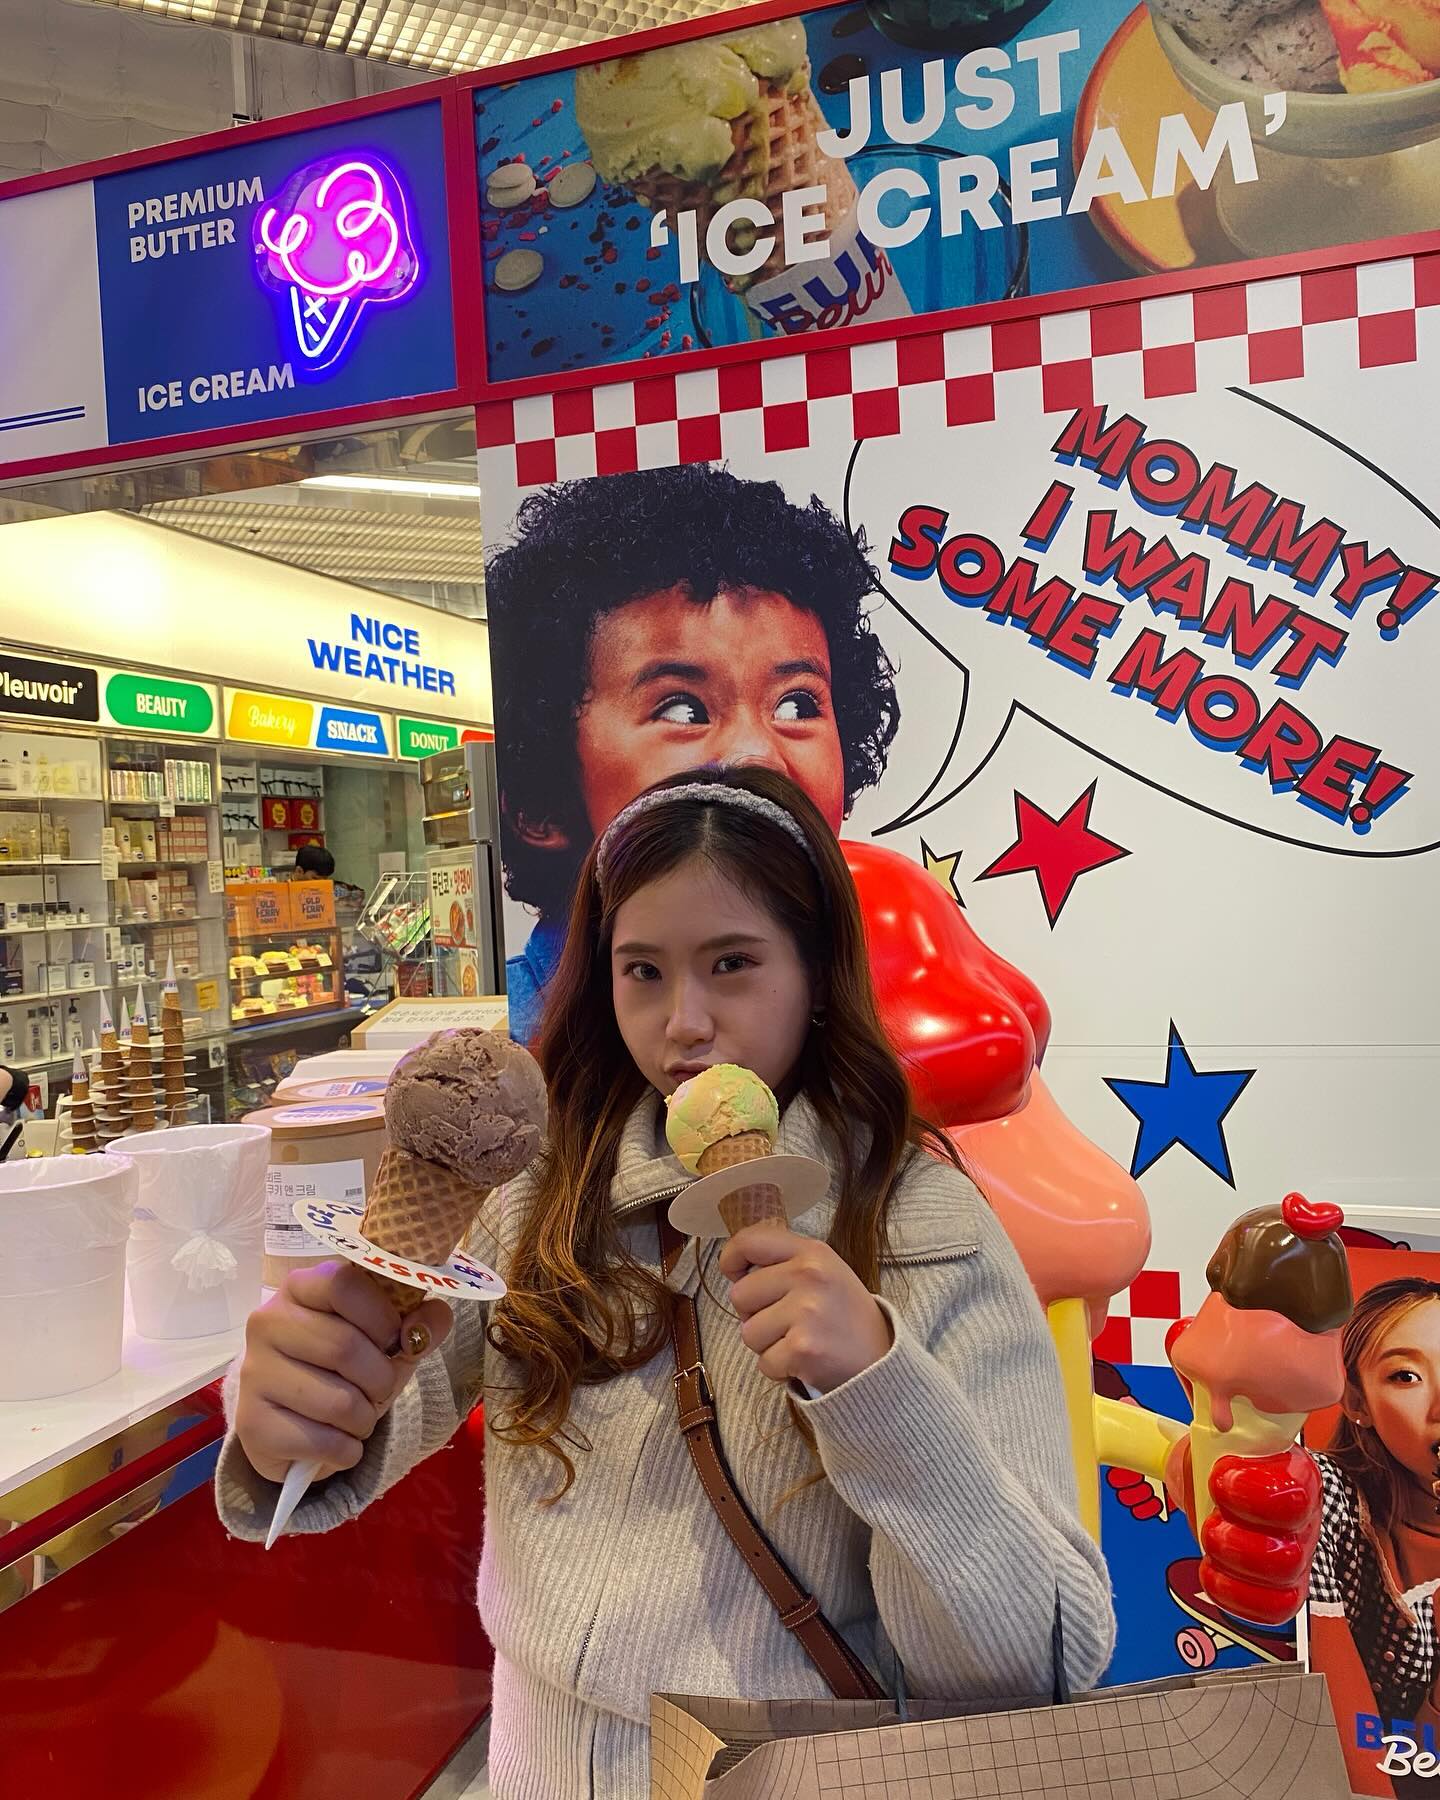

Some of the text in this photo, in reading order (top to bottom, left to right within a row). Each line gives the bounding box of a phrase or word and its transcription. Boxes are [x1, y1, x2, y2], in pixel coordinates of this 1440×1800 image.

[817, 29, 1081, 161] JUST
[128, 176, 265, 229] PREMIUM
[130, 218, 236, 263] BUTTER
[139, 362, 295, 413] ICE CREAM
[1050, 404, 1440, 641] MOMMY!
[1019, 480, 1350, 690] I WANT
[351, 613, 420, 656] NICE
[307, 639, 456, 696] WEATHER
[888, 505, 1414, 835] SOME MORE!
[136, 693, 187, 718] BEAUTY
[248, 704, 296, 737] Bakery
[327, 719, 378, 744] SNACK
[410, 731, 449, 752] DONUT
[296, 1184, 316, 1196] 크림
[363, 1256, 461, 1289] JUST
[1376, 1735, 1440, 1778] Be
